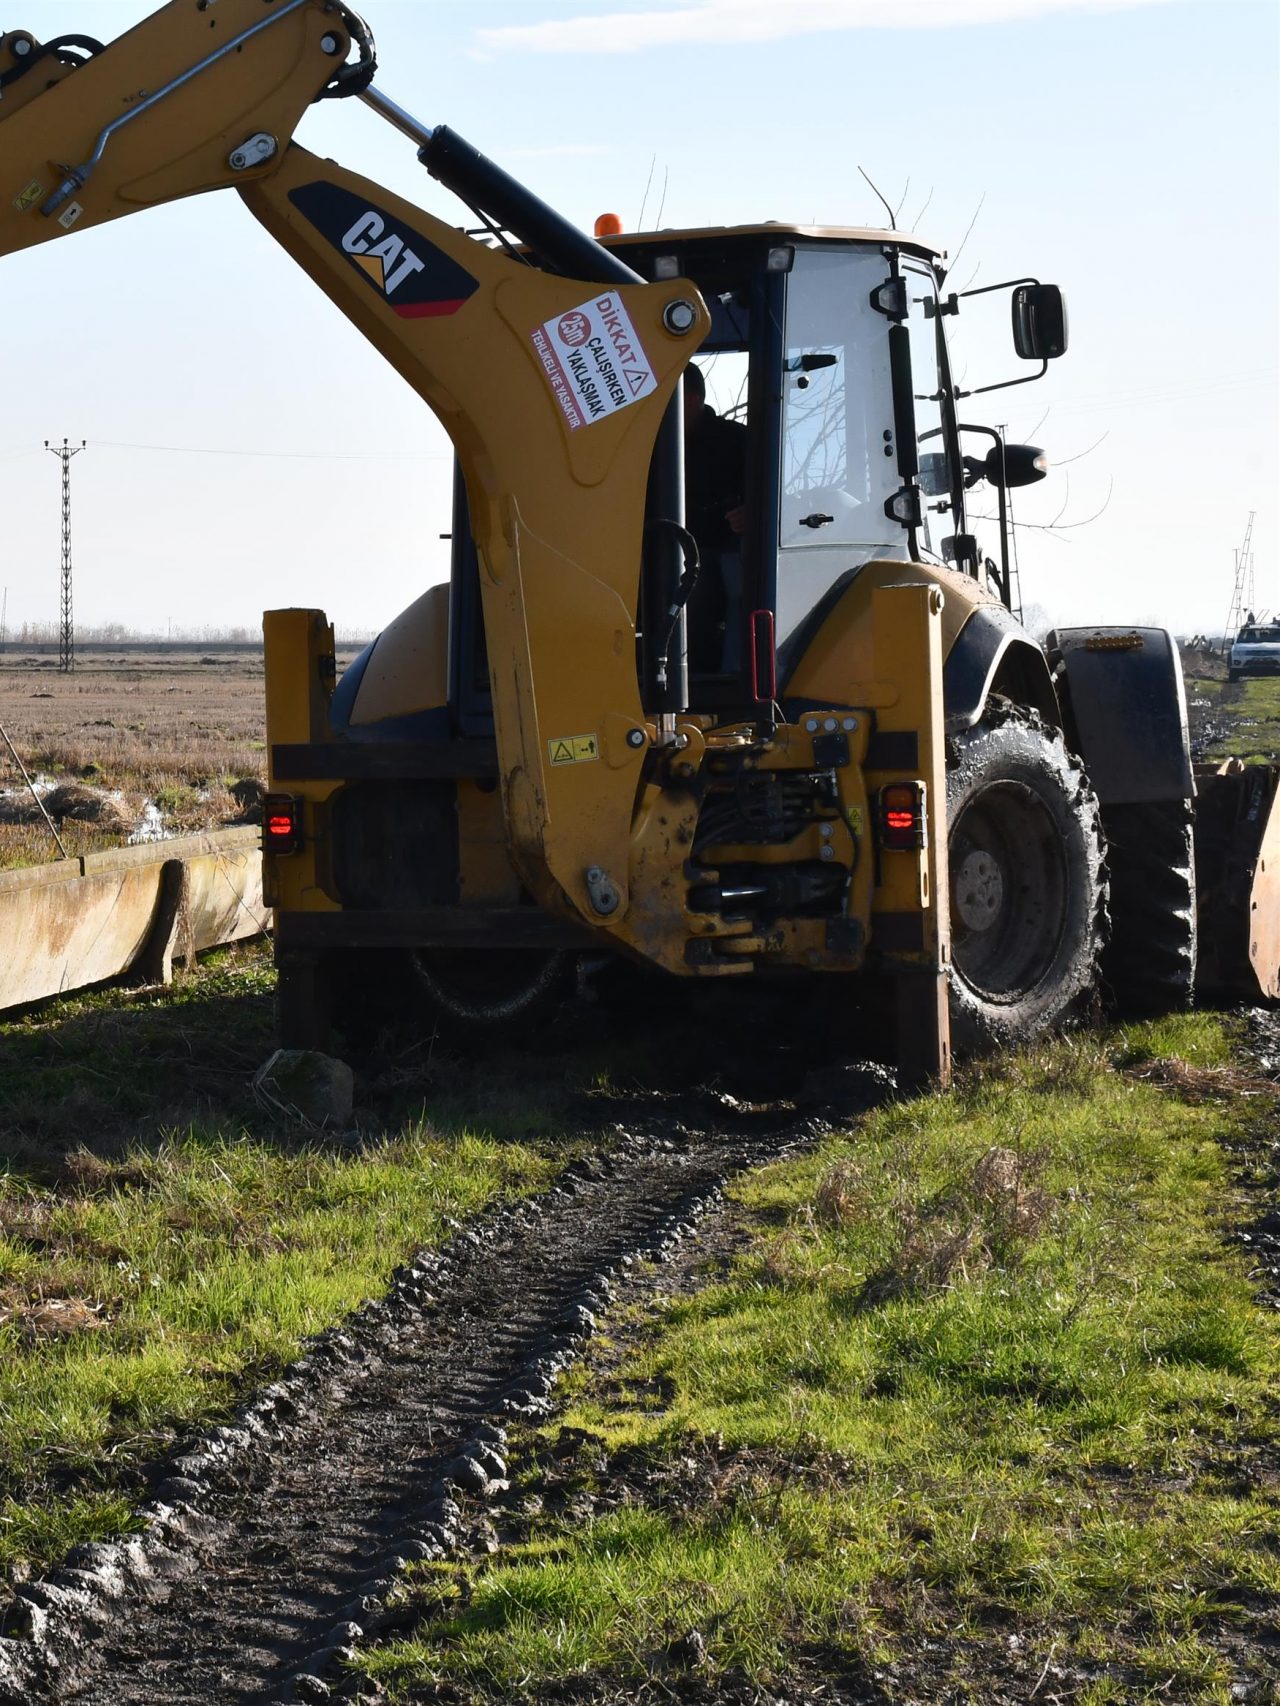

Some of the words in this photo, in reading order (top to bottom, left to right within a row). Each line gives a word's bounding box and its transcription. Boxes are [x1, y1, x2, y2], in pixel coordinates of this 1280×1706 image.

[341, 210, 426, 295] CAT
[560, 314, 585, 345] 25m
[596, 297, 637, 364] DİKKAT
[531, 330, 557, 375] TEHLİKELİ
[550, 373, 561, 387] VE
[556, 385, 581, 429] YASAKTIR
[567, 349, 606, 418] YAKLAŞMAK
[585, 337, 628, 406] ÇALIŞIRKEN
